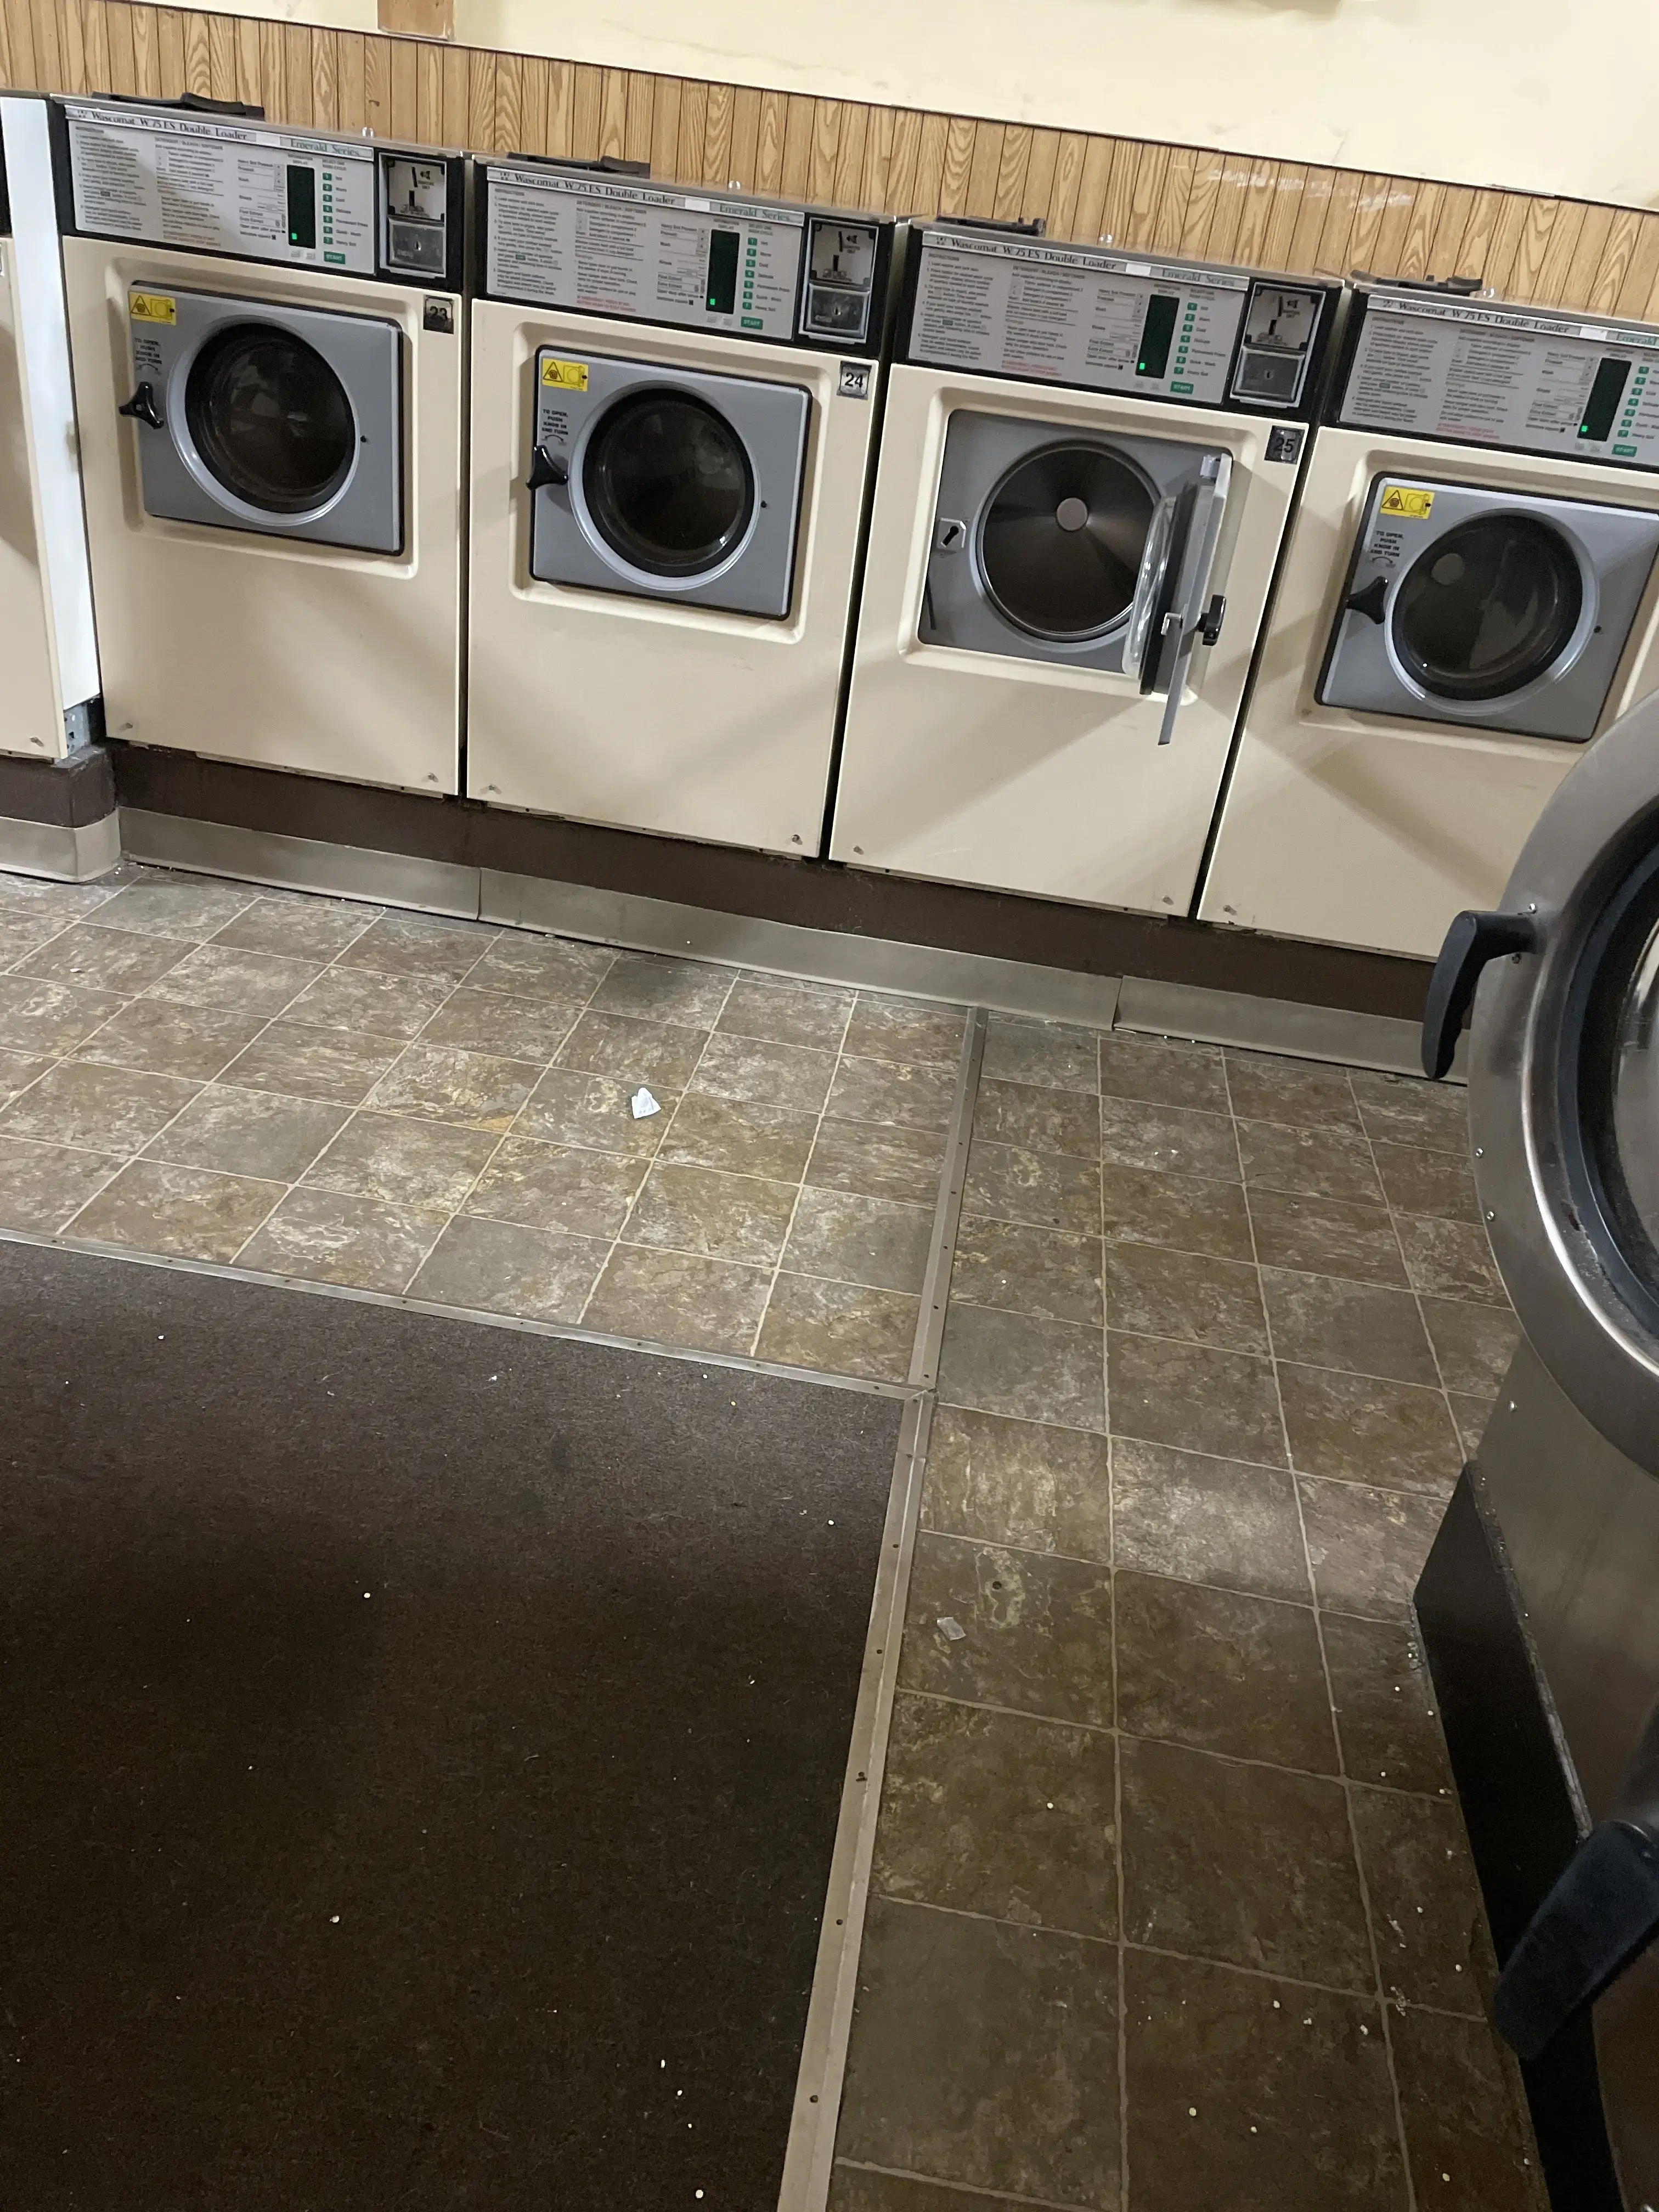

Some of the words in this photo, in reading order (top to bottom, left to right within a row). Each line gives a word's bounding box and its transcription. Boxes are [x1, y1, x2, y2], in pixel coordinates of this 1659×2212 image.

[92, 111, 135, 125] Wascomat
[140, 118, 148, 126] W
[179, 122, 211, 135] Double
[215, 127, 246, 140] Loader
[291, 139, 328, 153] Emerald
[332, 144, 359, 156] Series
[515, 173, 559, 188] Wascomat
[564, 181, 574, 190] W
[577, 183, 586, 192] 75
[606, 186, 638, 200] Double
[642, 191, 675, 205] Loader
[720, 204, 757, 217] Emerald
[762, 210, 790, 222] Series
[951, 238, 997, 253] Wascomat
[1003, 246, 1012, 255] W
[1015, 247, 1025, 256] 75
[1045, 251, 1077, 264] Double
[1082, 257, 1116, 270] Loader
[1163, 268, 1200, 282] Emerald
[1207, 274, 1234, 287] Series
[1399, 302, 1446, 316] Wascomat
[1452, 309, 1461, 318] W
[1495, 314, 1530, 328] Double
[1534, 321, 1569, 334] Loader
[845, 373, 864, 387] 24
[1276, 437, 1295, 454] 25
